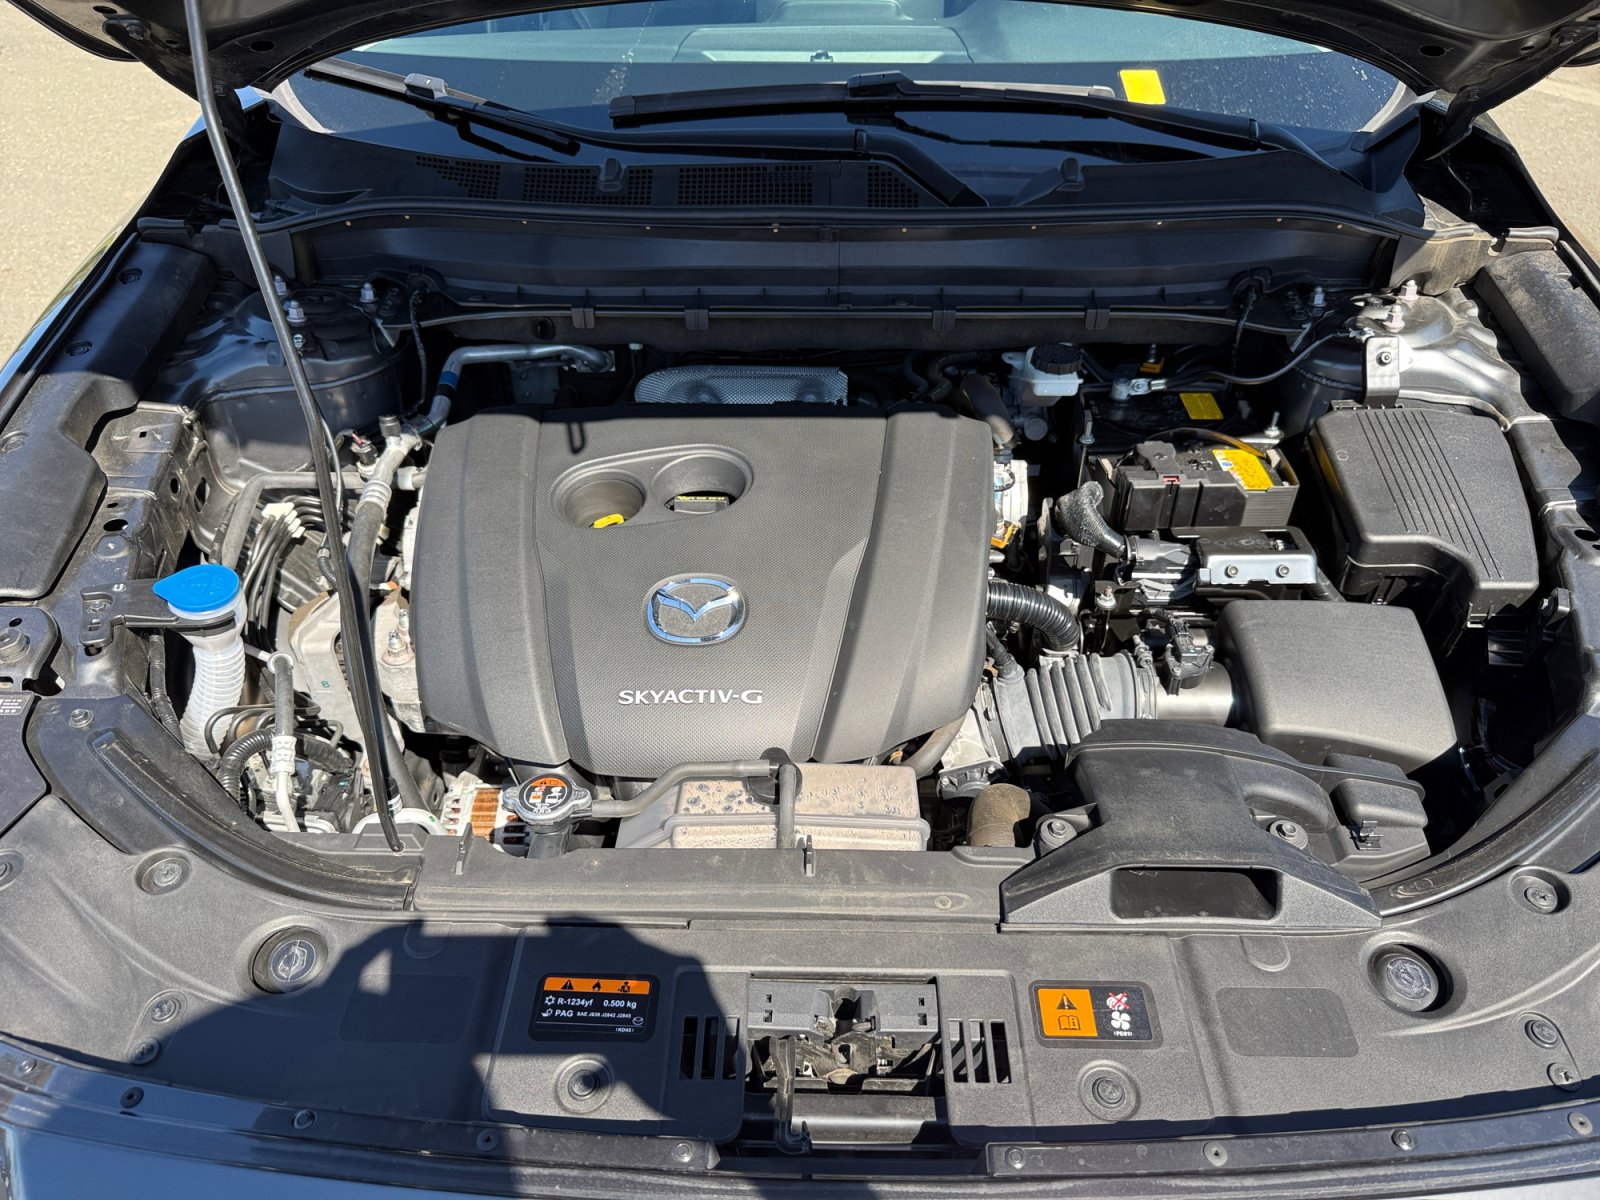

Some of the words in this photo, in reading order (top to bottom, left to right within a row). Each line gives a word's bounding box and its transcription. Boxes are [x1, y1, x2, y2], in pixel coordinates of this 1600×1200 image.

[618, 689, 763, 705] SKYACTIV-G
[557, 997, 594, 1007] R-1234yf
[603, 999, 625, 1007] 0.500
[626, 1000, 637, 1009] kg
[554, 1009, 574, 1017] PAG
